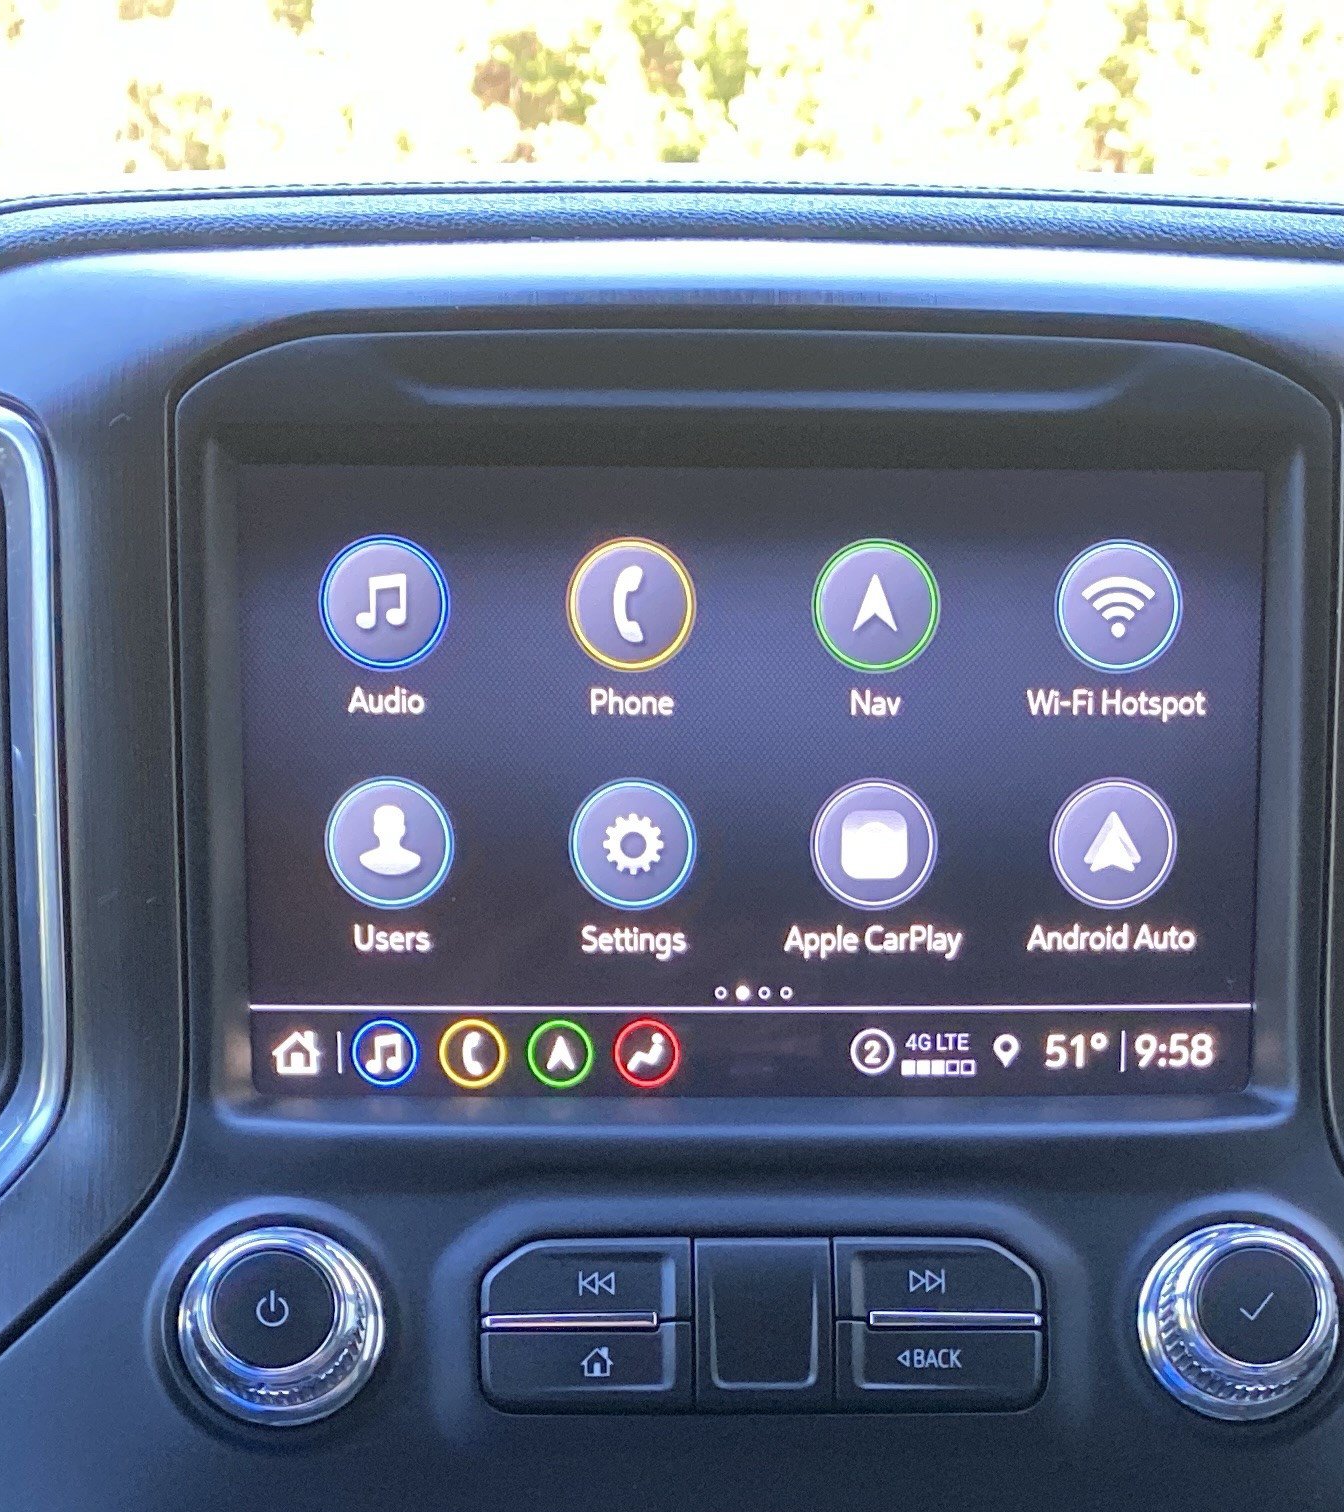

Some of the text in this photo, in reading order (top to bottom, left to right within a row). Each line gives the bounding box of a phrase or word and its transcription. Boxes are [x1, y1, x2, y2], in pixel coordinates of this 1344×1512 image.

[347, 685, 427, 716] Audio
[589, 686, 675, 717] Phone
[849, 687, 902, 718] Nav
[1026, 687, 1207, 723] Wi-Fi Hotspot
[353, 922, 433, 954] Users
[581, 923, 688, 961] Settings
[783, 922, 964, 961] Apple CarPlay
[1026, 922, 1197, 953] Android Auto
[905, 1033, 970, 1051] 4G LTE
[1044, 1031, 1109, 1070] 51°
[1134, 1031, 1215, 1069] 9:58
[913, 1348, 963, 1370] BACK
